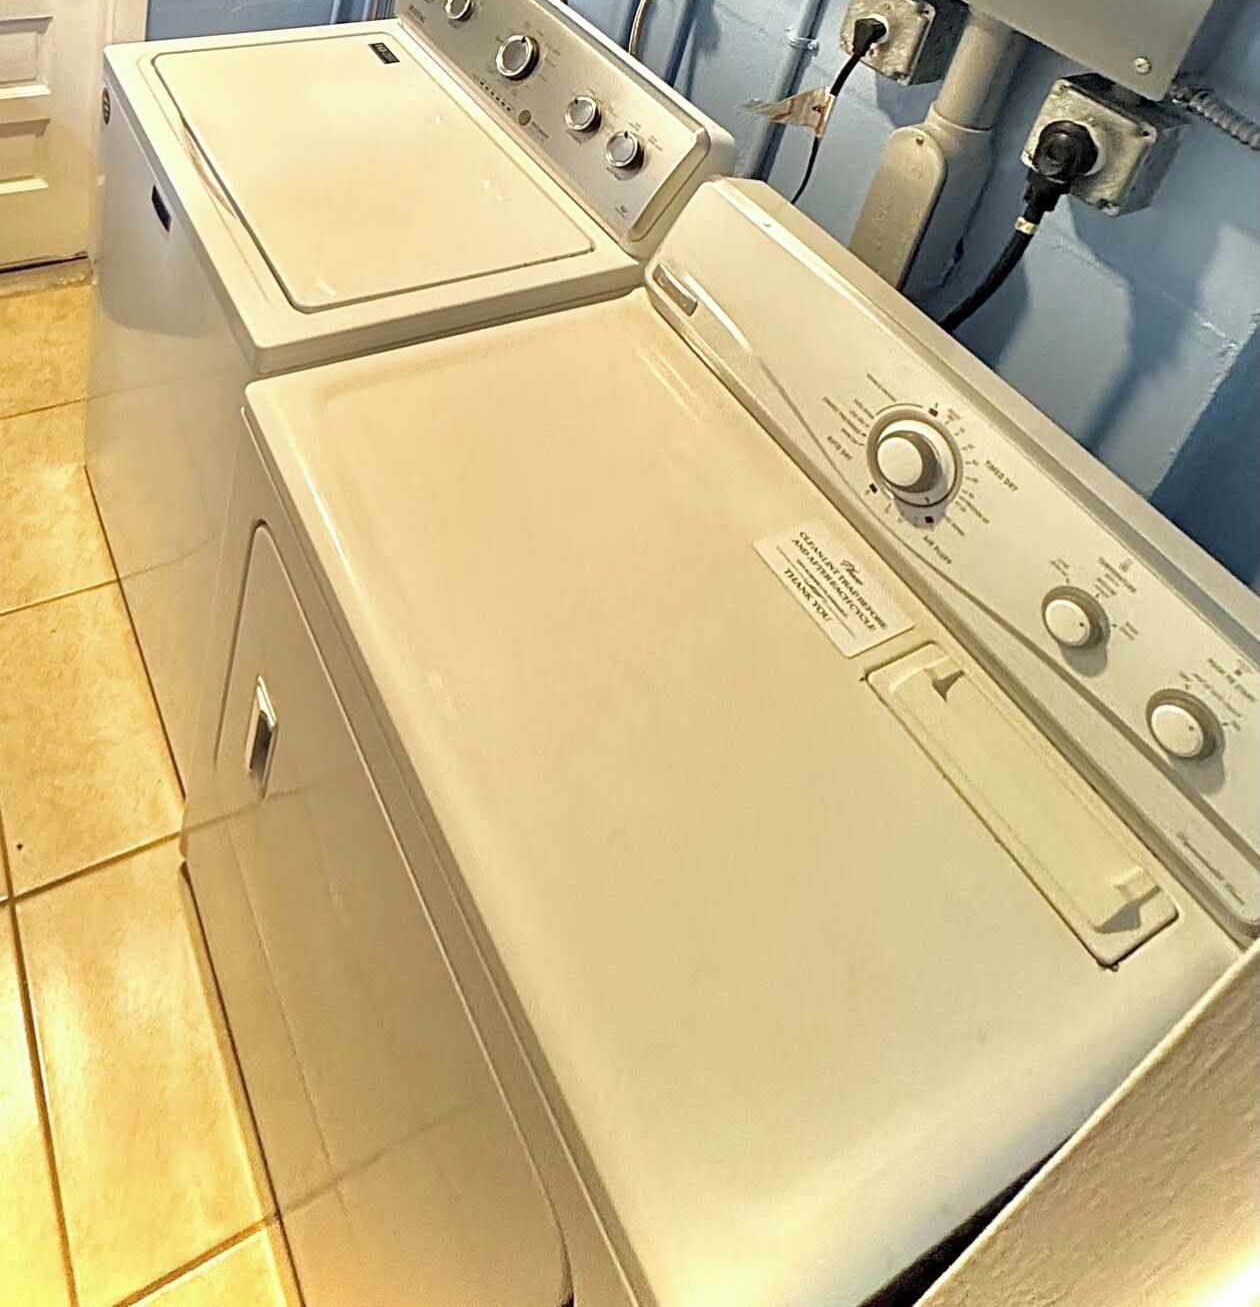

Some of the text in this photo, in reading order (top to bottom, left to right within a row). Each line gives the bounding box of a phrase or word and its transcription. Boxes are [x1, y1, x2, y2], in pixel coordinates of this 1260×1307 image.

[1003, 477, 1018, 492] DRY
[784, 567, 813, 601] THANK
[811, 600, 832, 622] YOU
[792, 538, 810, 556] AND
[808, 555, 833, 581] AFTER
[828, 580, 852, 604] EACH
[849, 603, 876, 631] CYCLE
[799, 531, 826, 559] CLEAN
[822, 556, 840, 575] LINT
[837, 574, 860, 598] TRAP
[856, 595, 887, 629] BEFORE
